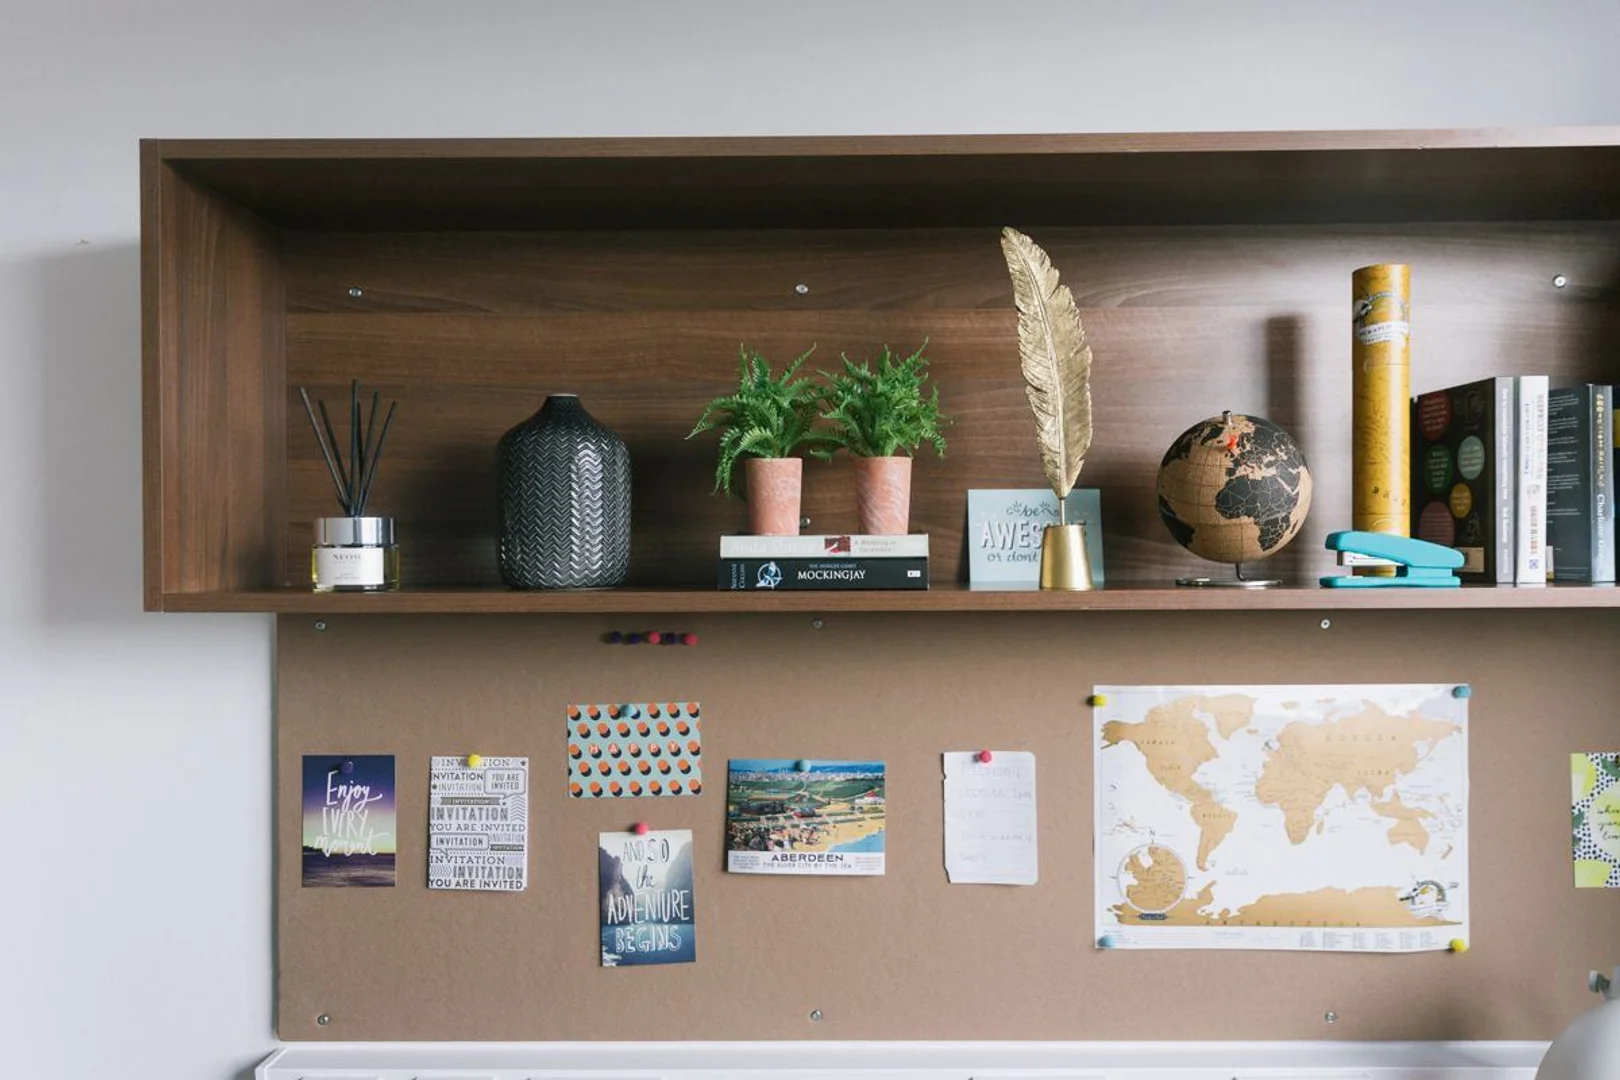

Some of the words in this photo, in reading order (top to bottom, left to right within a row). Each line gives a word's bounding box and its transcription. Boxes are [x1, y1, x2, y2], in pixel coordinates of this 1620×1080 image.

[1020, 505, 1039, 517] be
[797, 569, 866, 581] MOCKINGJAY
[588, 742, 679, 755] HAPPY
[432, 772, 483, 780] NVITATION
[326, 769, 383, 813] Enjoy
[492, 782, 520, 790] INVITED
[432, 807, 508, 821] INVITATION
[430, 823, 452, 831] YOU
[456, 823, 477, 831] ARE
[481, 823, 526, 832] INVITED
[436, 837, 483, 846] INVITATION
[622, 840, 643, 862] AND
[646, 838, 670, 863] SO
[430, 855, 504, 865] INVITATION
[771, 853, 844, 863] ABERDEEN
[453, 866, 523, 880] INVITATION
[636, 864, 656, 890] the
[430, 878, 451, 887] YOU
[455, 879, 475, 888] ARE
[480, 880, 523, 889] INVITED
[607, 889, 690, 925] ADVENTURE
[615, 925, 682, 953] BEGINS
